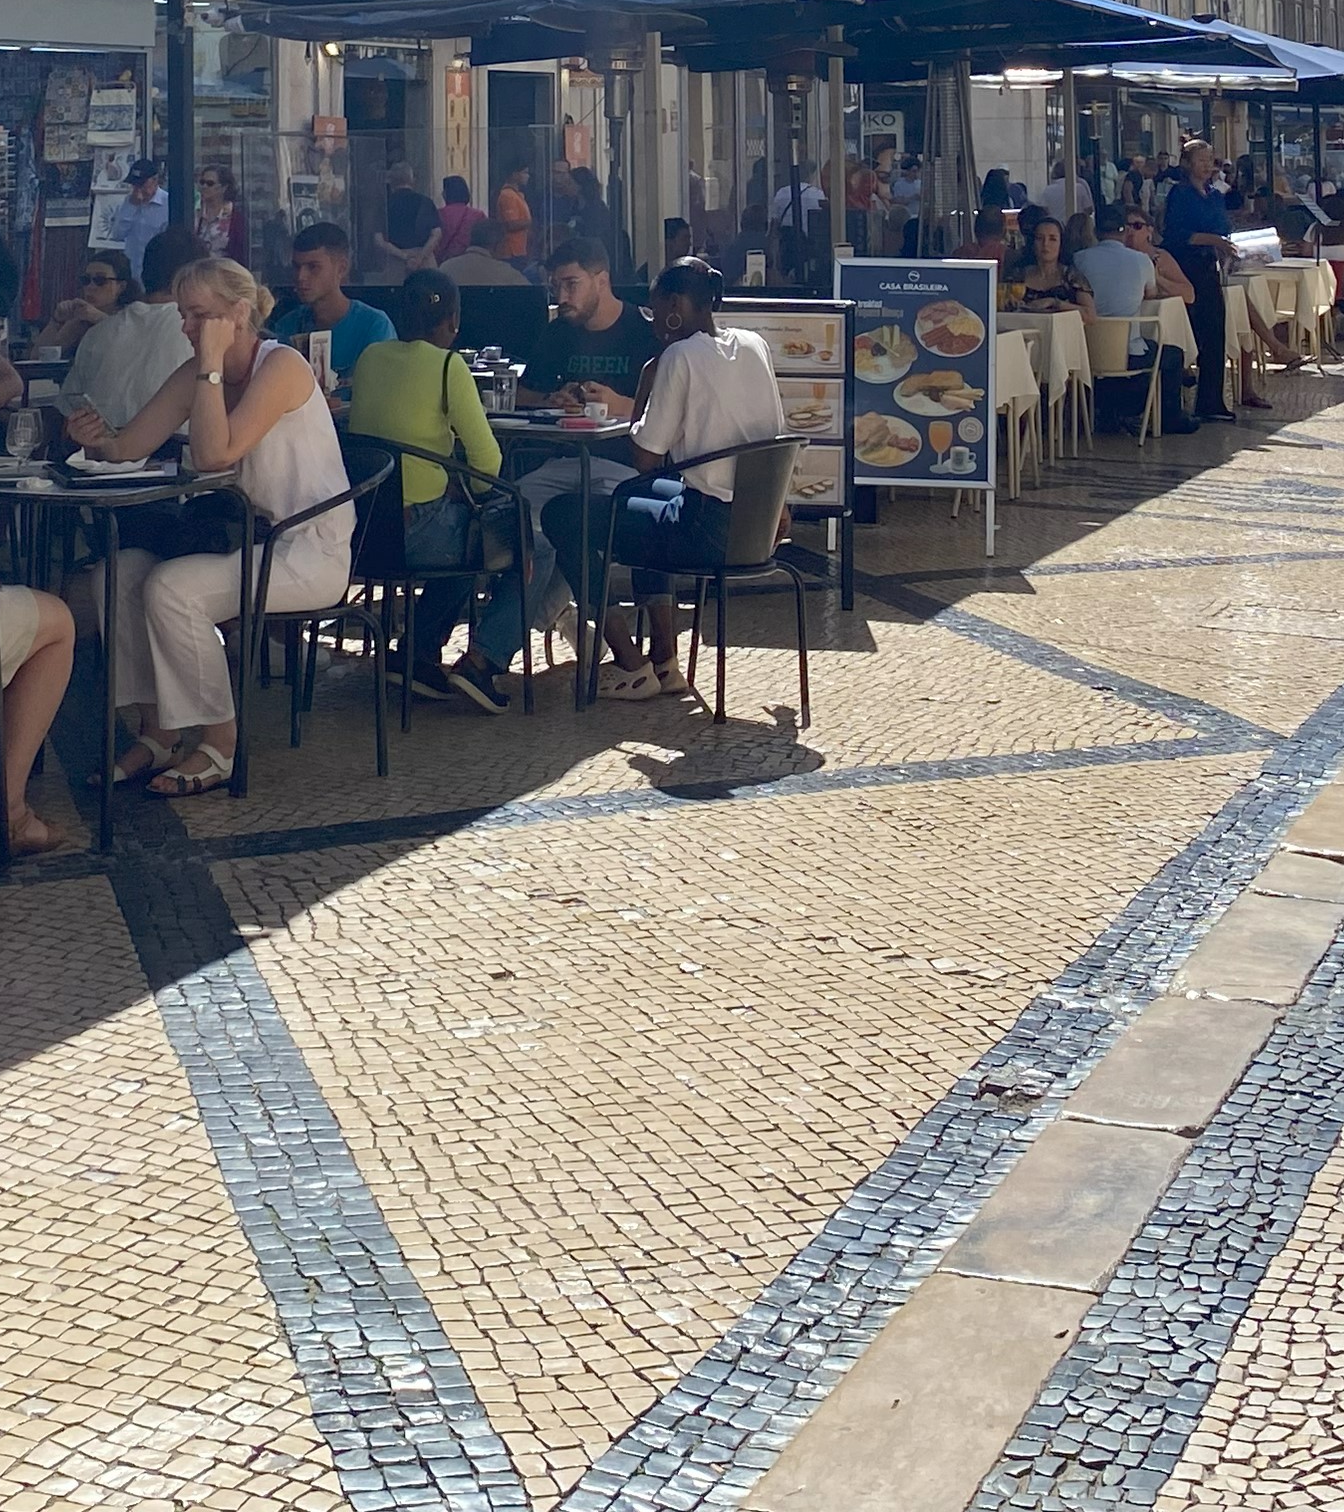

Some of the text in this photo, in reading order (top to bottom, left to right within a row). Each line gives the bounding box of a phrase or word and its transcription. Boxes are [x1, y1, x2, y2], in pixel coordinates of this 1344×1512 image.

[879, 282, 949, 293] CASA BRASILEIRA
[566, 354, 631, 375] GREEN
